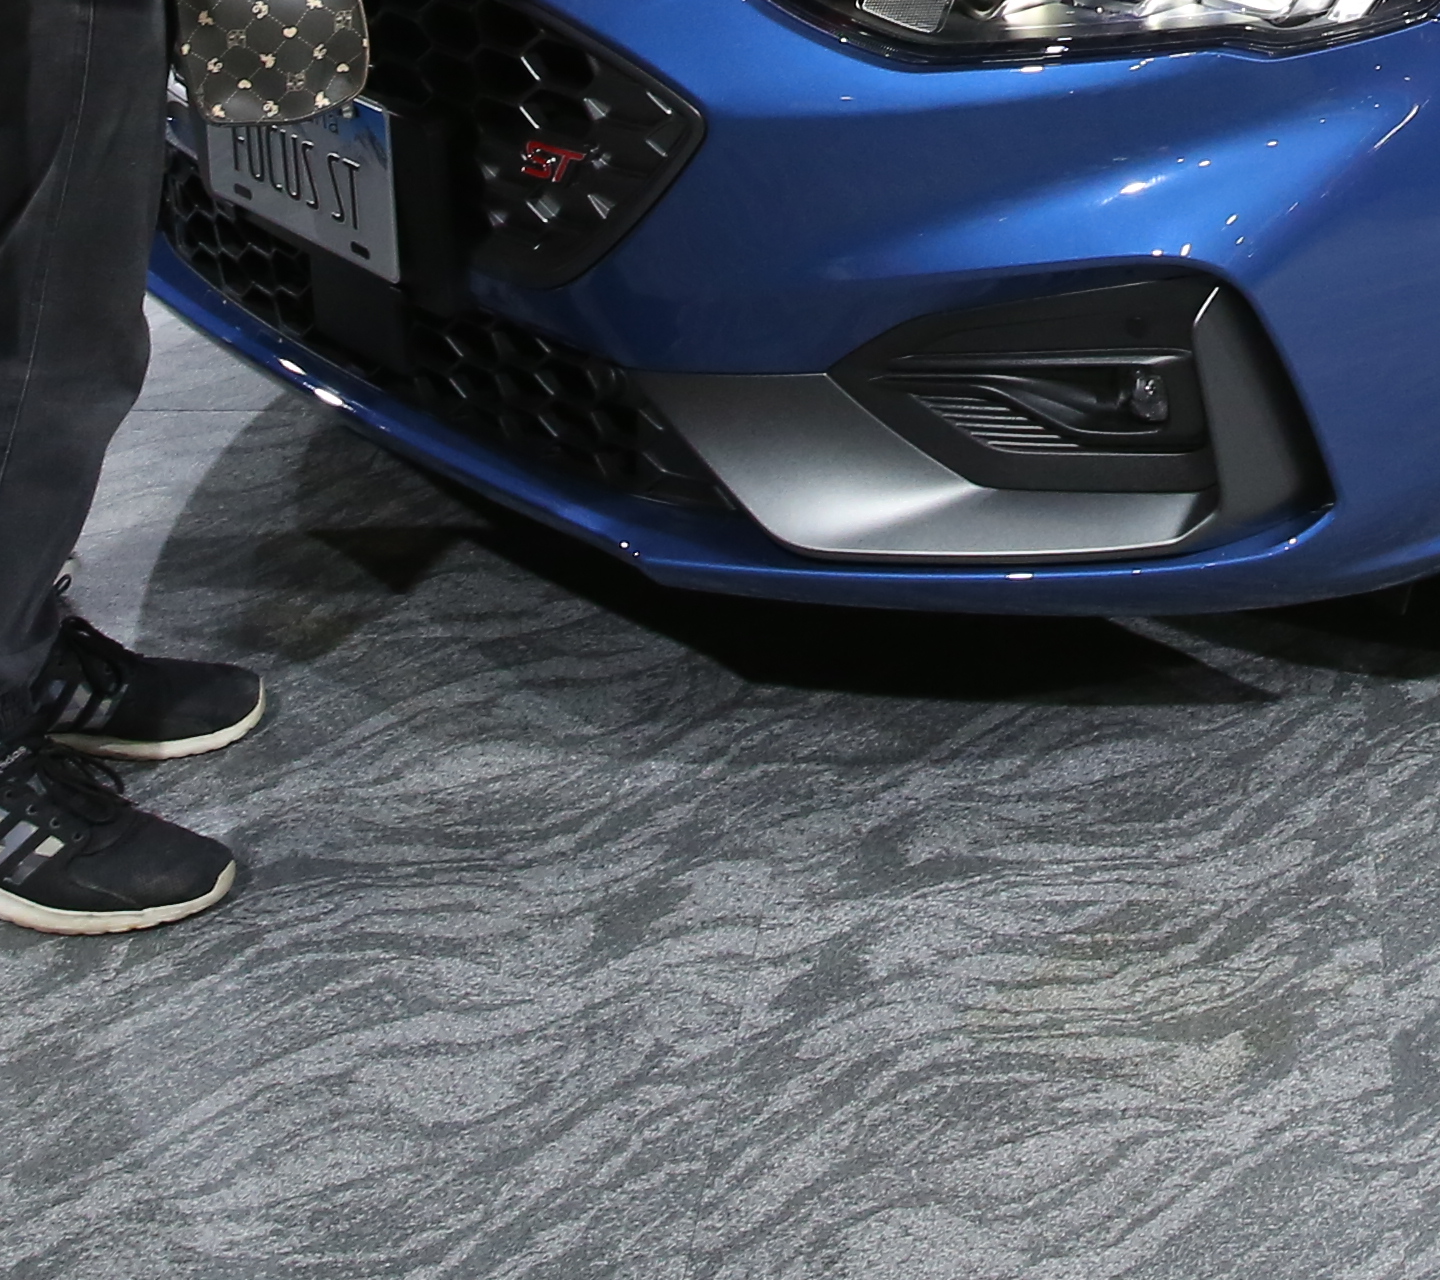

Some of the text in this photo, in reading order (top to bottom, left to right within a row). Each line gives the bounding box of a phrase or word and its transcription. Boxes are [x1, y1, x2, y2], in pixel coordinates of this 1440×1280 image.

[231, 125, 361, 230] FOCUS ST
[520, 141, 587, 183] ST
